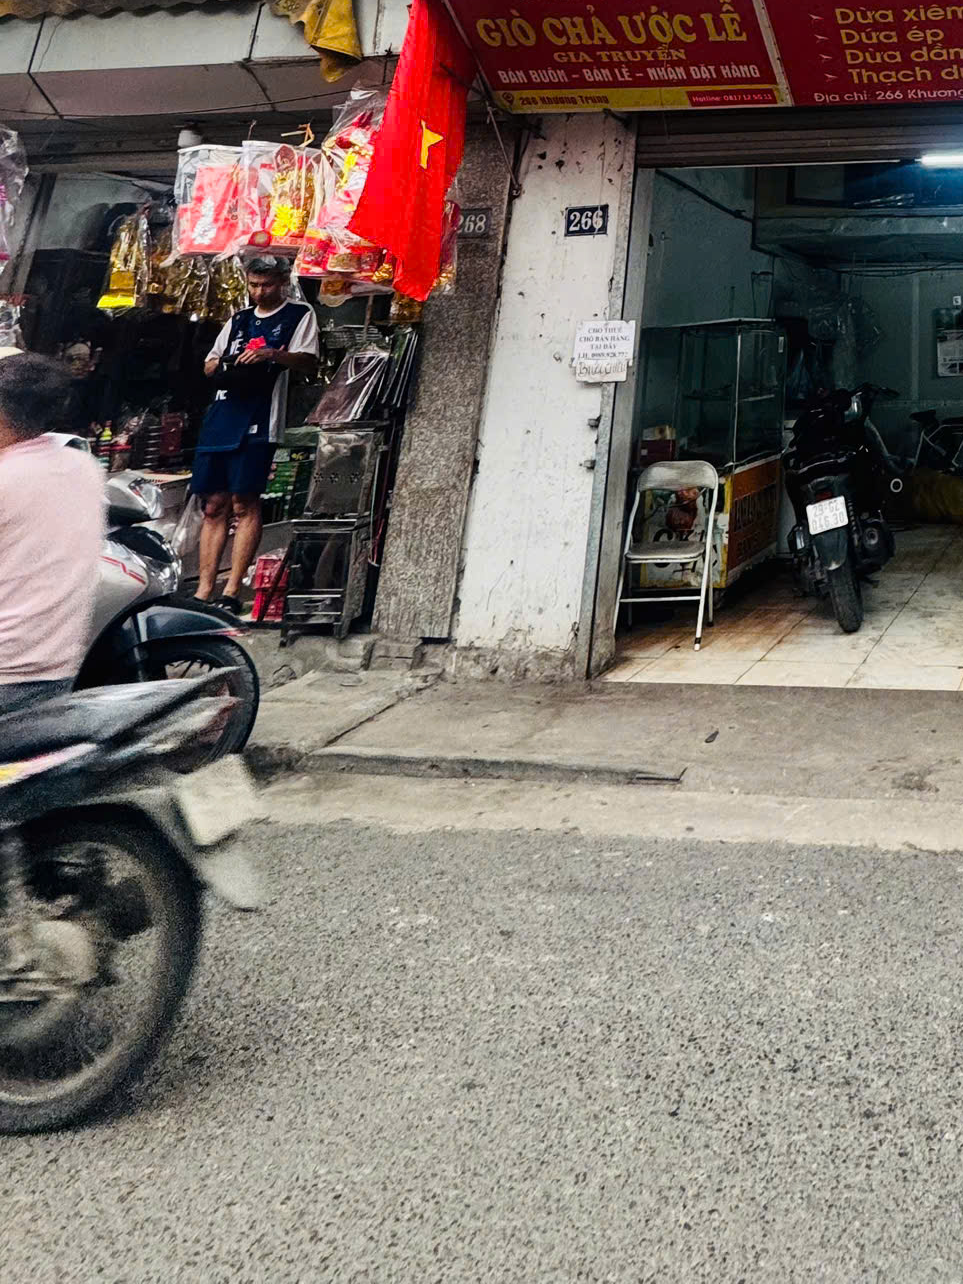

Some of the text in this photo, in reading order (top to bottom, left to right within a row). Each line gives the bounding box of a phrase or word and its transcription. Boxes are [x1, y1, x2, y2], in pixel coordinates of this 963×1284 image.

[834, 6, 895, 25] Dừa
[476, 8, 537, 47] GIÒ
[542, 4, 617, 46] CHẢ
[906, 26, 945, 44] ép
[553, 51, 594, 63] GIA
[845, 48, 902, 65] Dừa
[498, 62, 761, 84] BÁN BUÔN BÁN LẺ NHẬN ĐẶT HÀNG
[848, 67, 932, 86] Thạch
[580, 94, 610, 105] Trung
[876, 90, 904, 101] 266
[568, 210, 604, 232] 266
